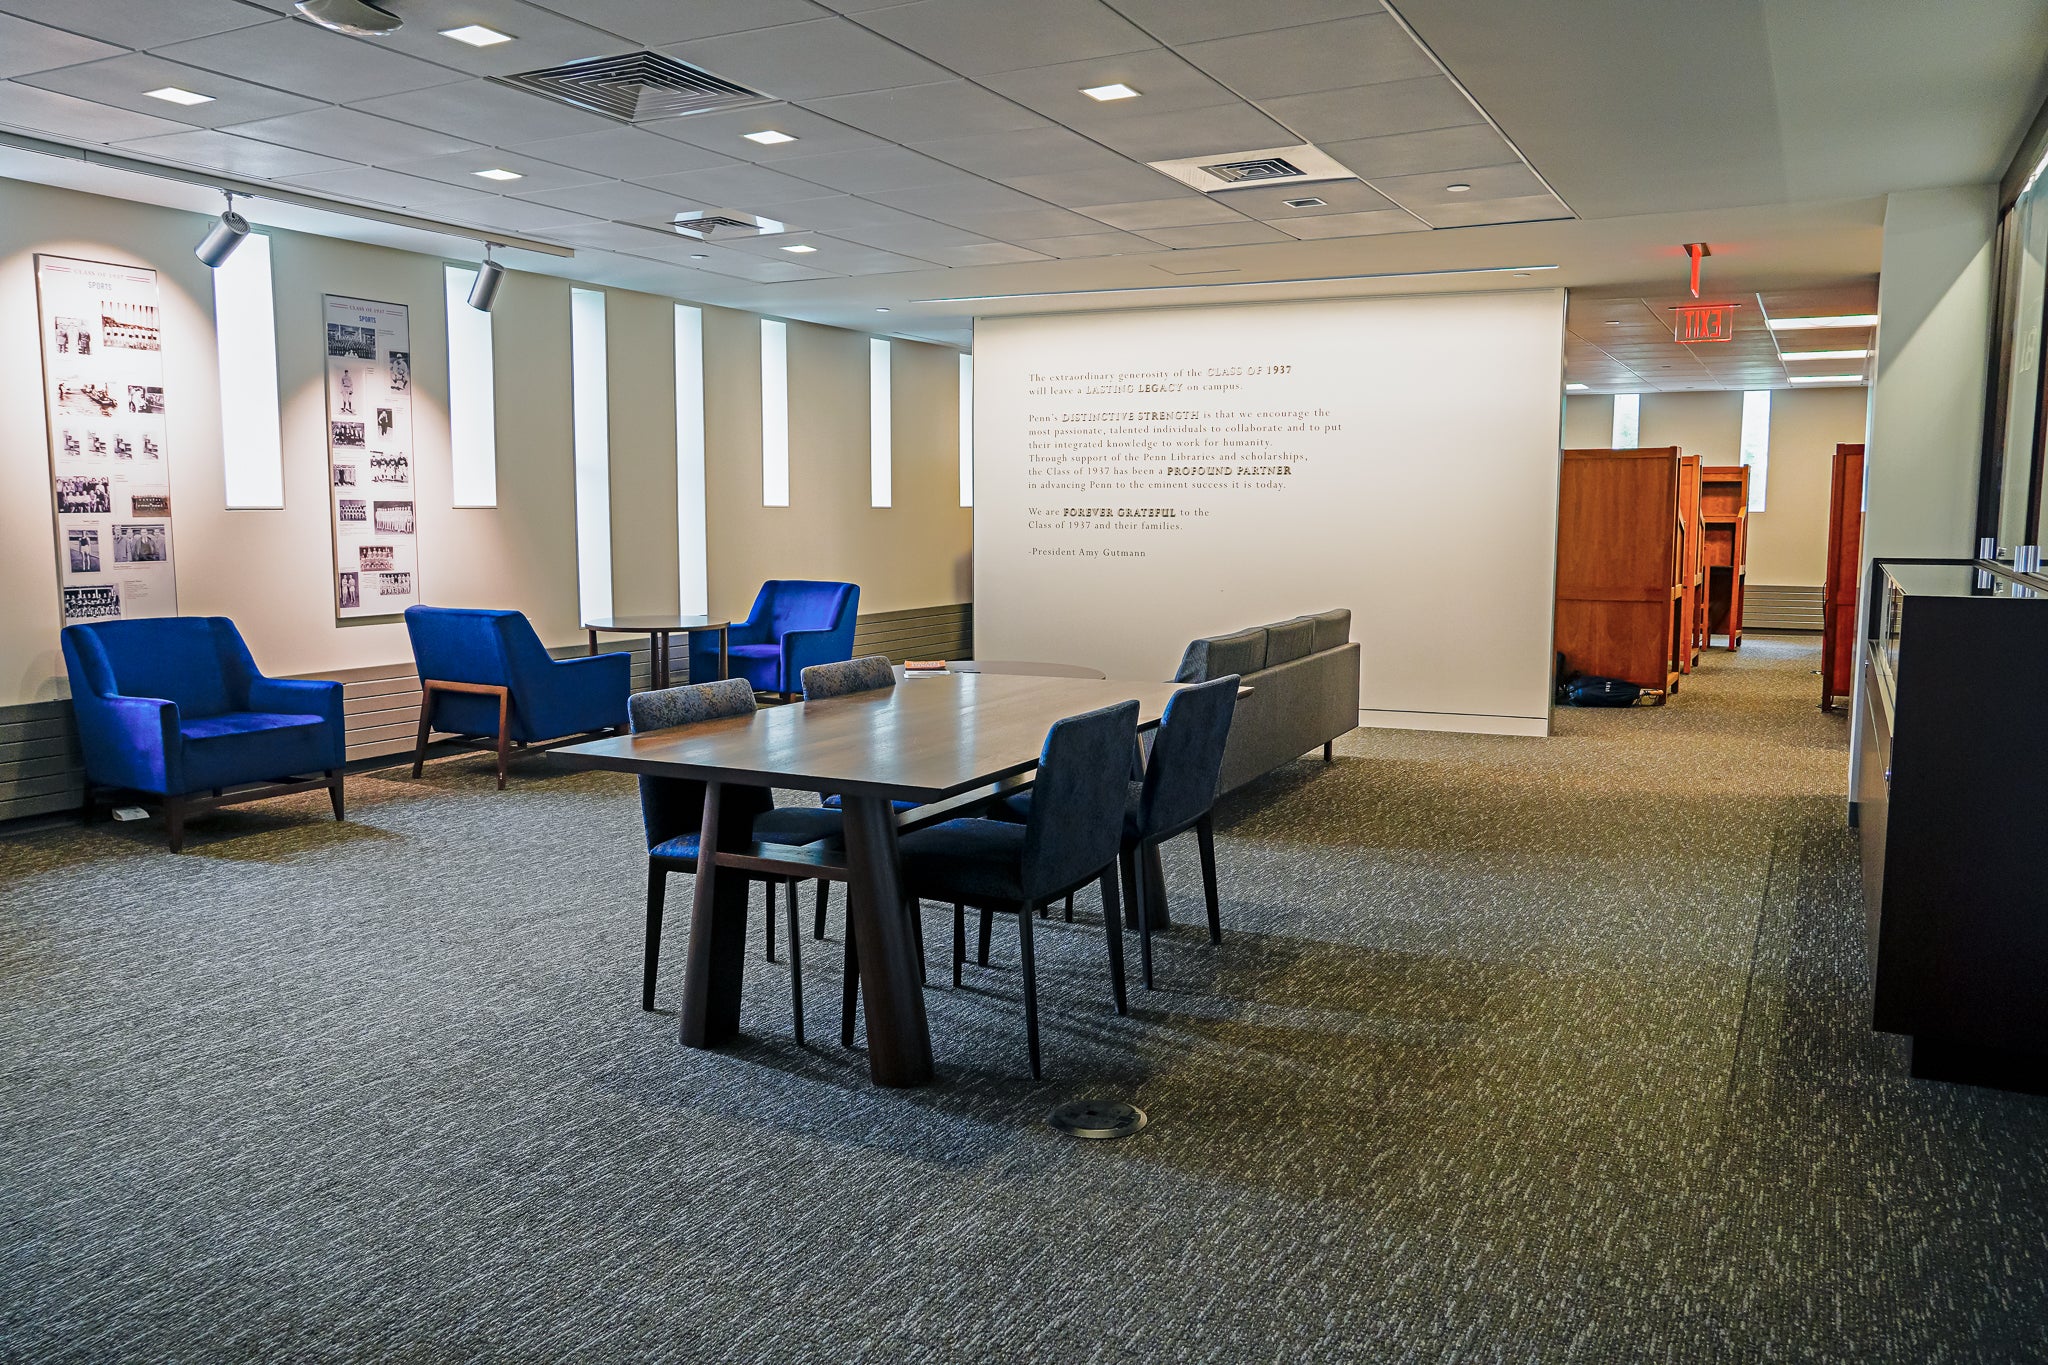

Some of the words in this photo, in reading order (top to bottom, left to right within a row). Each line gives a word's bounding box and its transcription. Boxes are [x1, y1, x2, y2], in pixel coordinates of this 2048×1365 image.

[88, 281, 113, 291] SPORTS
[358, 315, 377, 324] SPORTS
[1029, 373, 1046, 382] The
[1049, 372, 1115, 382] extraordinary
[1118, 370, 1169, 381] generosity
[1173, 368, 1184, 378] of
[1187, 368, 1203, 378] the
[1207, 366, 1243, 378] CLASS
[1247, 366, 1263, 377] OF
[1266, 364, 1292, 376] 1937
[1029, 387, 1047, 396] will
[1050, 386, 1074, 395] leave
[1085, 385, 1134, 395] LASTING
[1139, 383, 1183, 394] LEGACY
[1187, 384, 1199, 392] on
[1202, 383, 1243, 393] campus.
[1029, 413, 1059, 423] Penn's
[1062, 412, 1134, 423] DISTINCTIVE
[1138, 411, 1199, 421] STRENGTH
[1203, 411, 1211, 419] is
[1215, 410, 1235, 419] that
[1239, 411, 1252, 419] we
[1256, 410, 1311, 421] encourage
[1314, 408, 1331, 418] the
[1029, 428, 1051, 436] most
[1054, 427, 1106, 438] passionate,
[1109, 425, 1149, 435] talented
[1153, 424, 1207, 434] individuals
[1211, 424, 1222, 433] to
[1225, 423, 1283, 433] collaborate
[1287, 423, 1305, 432] and
[1309, 423, 1320, 432] to
[1324, 423, 1343, 435] put
[1029, 440, 1050, 449] their
[1054, 439, 1104, 452] integrated
[1107, 439, 1158, 450] knowledge
[1162, 439, 1173, 448] to
[1176, 438, 1200, 448] work
[1204, 438, 1219, 447] for
[1223, 437, 1273, 450] humanity.
[1029, 454, 1067, 465] Through
[1071, 454, 1107, 465] support
[1111, 452, 1122, 462] of
[1124, 453, 1140, 462] the
[1143, 452, 1166, 462] Penn
[1171, 452, 1216, 462] Libraries
[1219, 451, 1236, 461] and
[1241, 451, 1309, 464] scholarships,
[1028, 467, 1044, 477] the
[1046, 467, 1070, 477] Class
[1073, 466, 1084, 476] of
[1087, 466, 1110, 476] 1937
[1113, 466, 1129, 476] has
[1132, 466, 1155, 476] been
[1158, 468, 1164, 476] a
[1167, 466, 1233, 477] PROFOUND
[1237, 466, 1292, 476] PARTNER
[1028, 480, 1037, 489] in
[1040, 480, 1086, 492] advancing
[1090, 480, 1112, 489] Penn
[1116, 481, 1126, 489] to
[1129, 480, 1144, 489] the
[1148, 480, 1188, 489] eminent
[1192, 481, 1228, 489] success
[1232, 480, 1240, 489] it
[1244, 480, 1252, 489] is
[1255, 479, 1286, 491] today.
[1028, 507, 1042, 516] We
[1063, 508, 1114, 518] FOREVER
[1118, 507, 1177, 518] GRATEFUL
[1180, 509, 1191, 517] to
[1194, 508, 1210, 517] the
[1028, 521, 1052, 530] Class
[1055, 520, 1065, 530] of
[1068, 521, 1091, 530] 1937
[1094, 521, 1111, 530] and
[1114, 520, 1138, 530] their
[1141, 521, 1183, 531] families.
[1079, 548, 1099, 560] Amy
[1102, 548, 1146, 558] Gutmann
